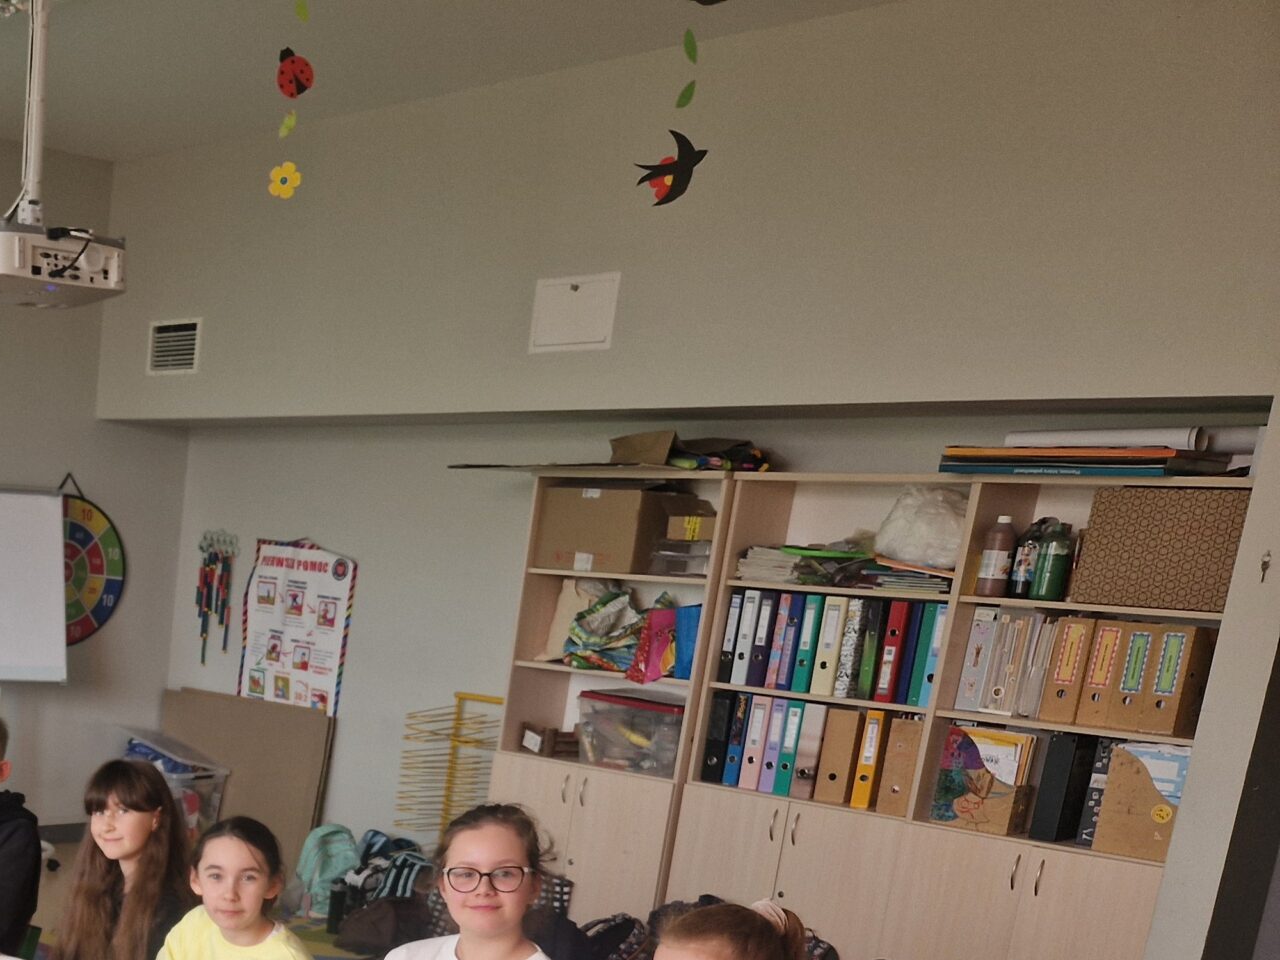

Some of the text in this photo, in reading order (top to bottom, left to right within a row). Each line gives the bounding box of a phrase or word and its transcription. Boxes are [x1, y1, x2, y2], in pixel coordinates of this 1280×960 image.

[82, 508, 93, 522] 10
[107, 547, 120, 560] 10
[296, 559, 329, 573] POMOC
[102, 594, 115, 607] 10
